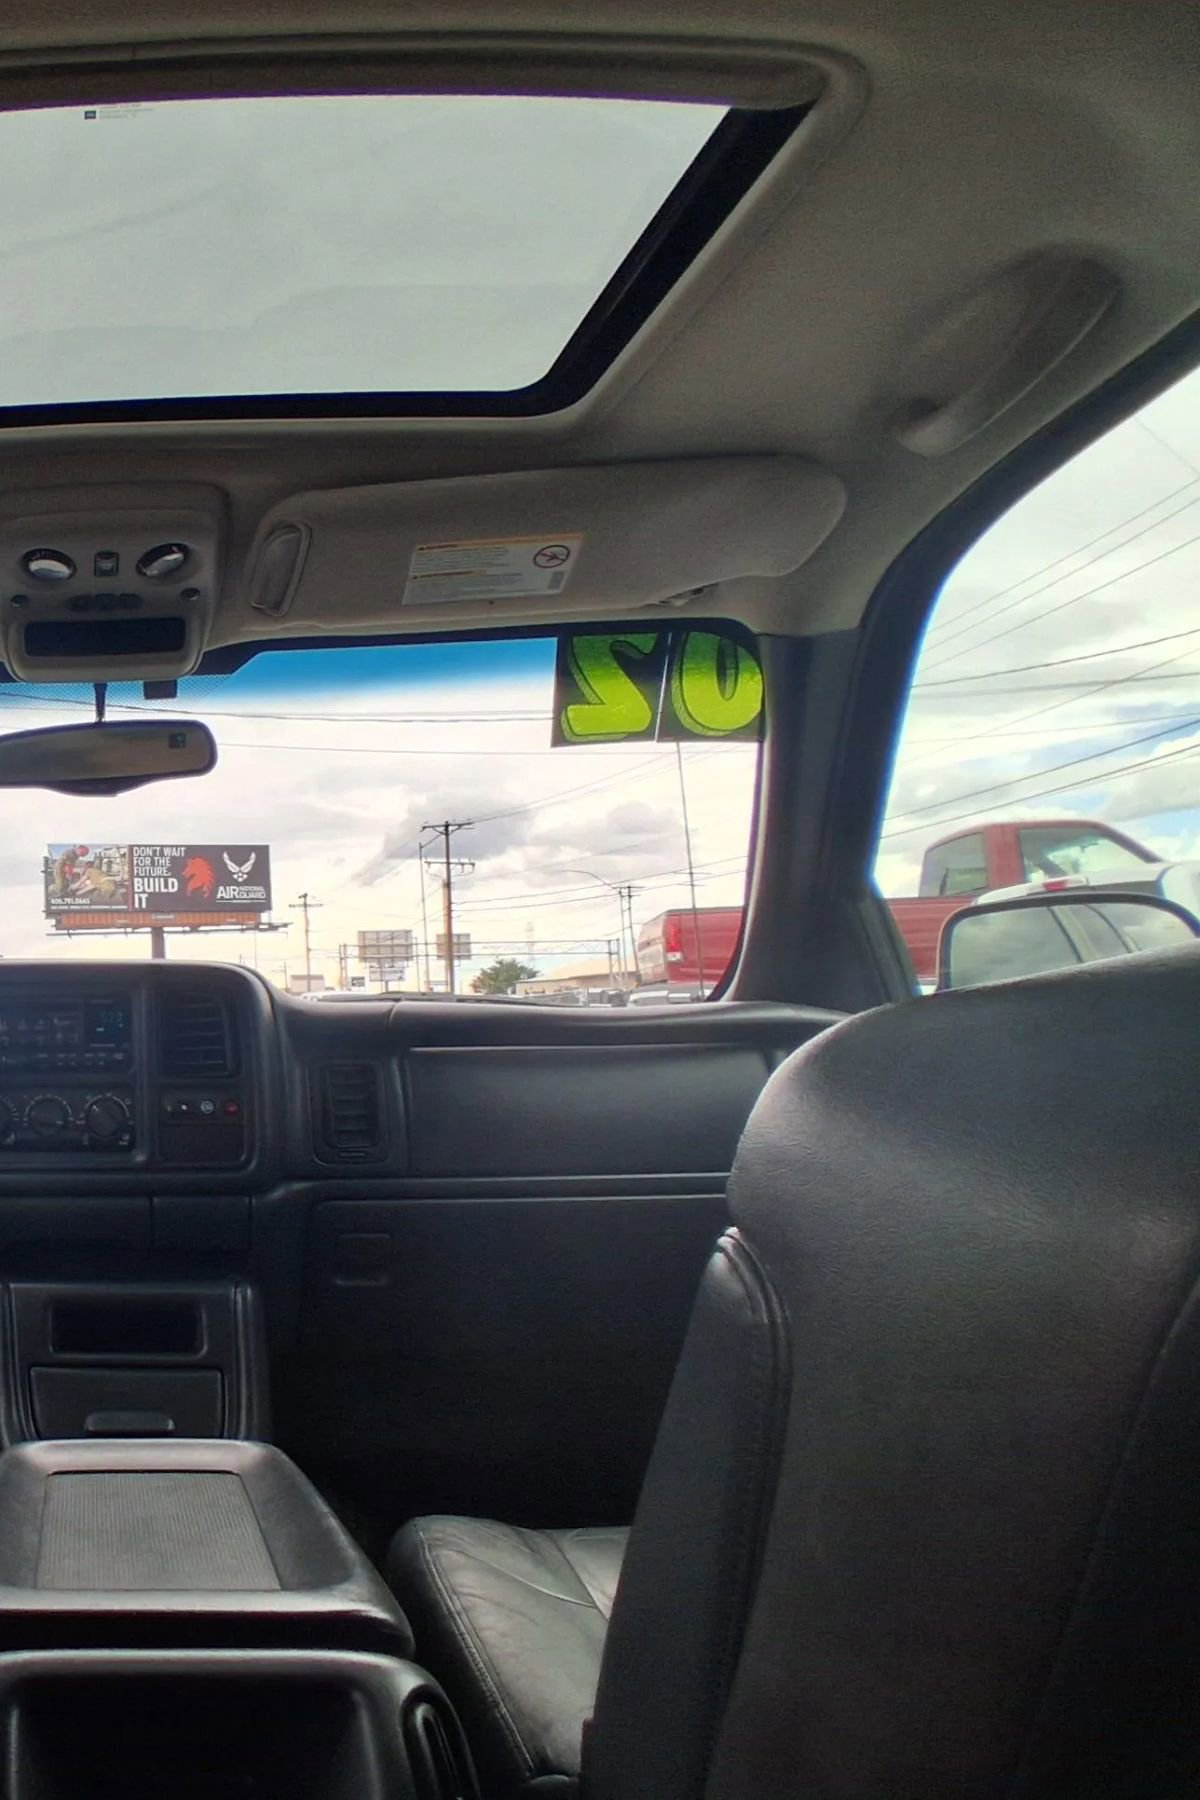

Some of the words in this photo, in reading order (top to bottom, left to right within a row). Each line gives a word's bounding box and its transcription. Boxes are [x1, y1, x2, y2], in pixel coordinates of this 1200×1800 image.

[133, 846, 161, 857] DON'T
[163, 847, 186, 857] WAIT
[133, 857, 152, 866] FOR
[154, 857, 172, 866] THE
[134, 866, 171, 877] FUTURE.
[133, 877, 178, 893] BUILD
[216, 885, 239, 899] AIR
[134, 893, 149, 909] IT
